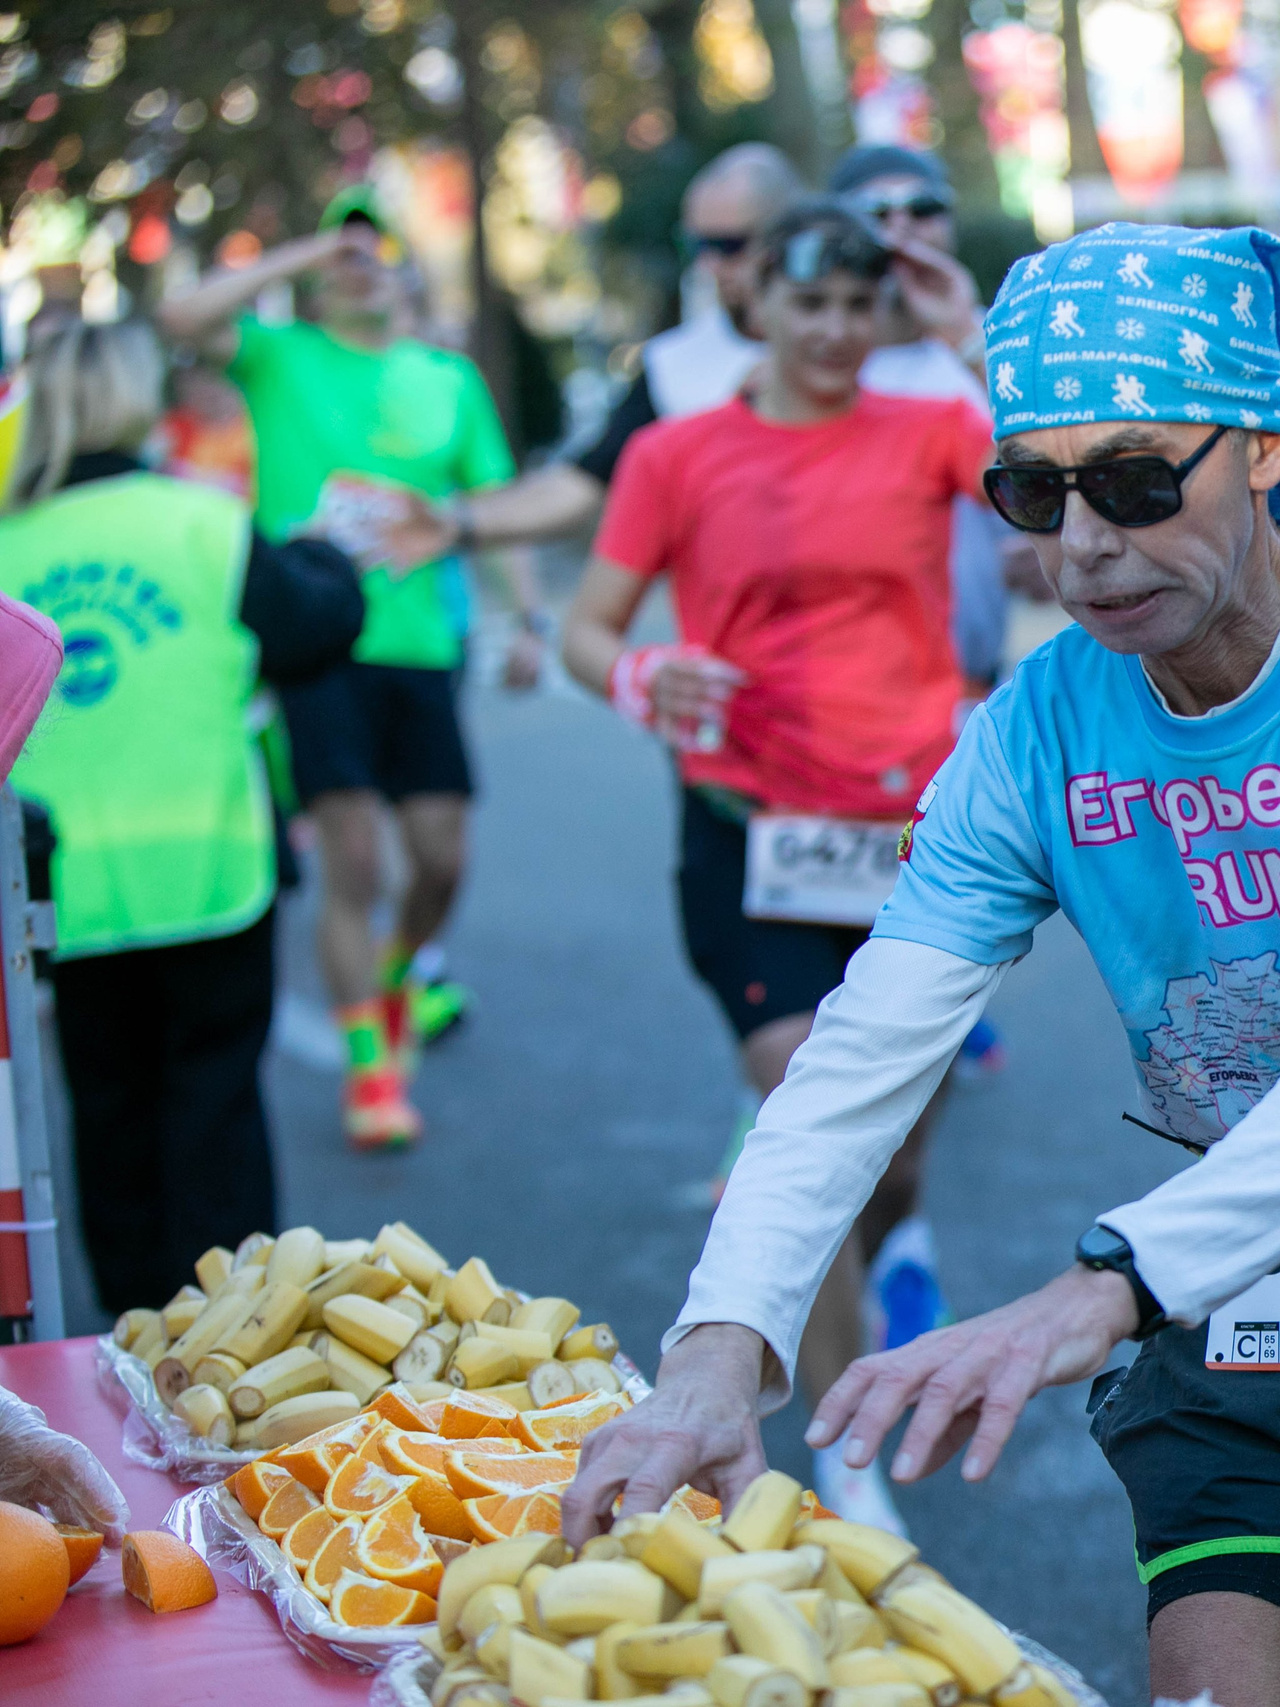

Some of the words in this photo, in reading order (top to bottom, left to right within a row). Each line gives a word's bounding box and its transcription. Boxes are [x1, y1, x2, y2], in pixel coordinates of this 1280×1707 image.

[1116, 295, 1219, 327] ЗЕЛЕНОГРАД
[1043, 350, 1168, 369] БИМ-МАРАФОН
[1264, 1335, 1276, 1344] 65
[1263, 1349, 1276, 1359] 69
